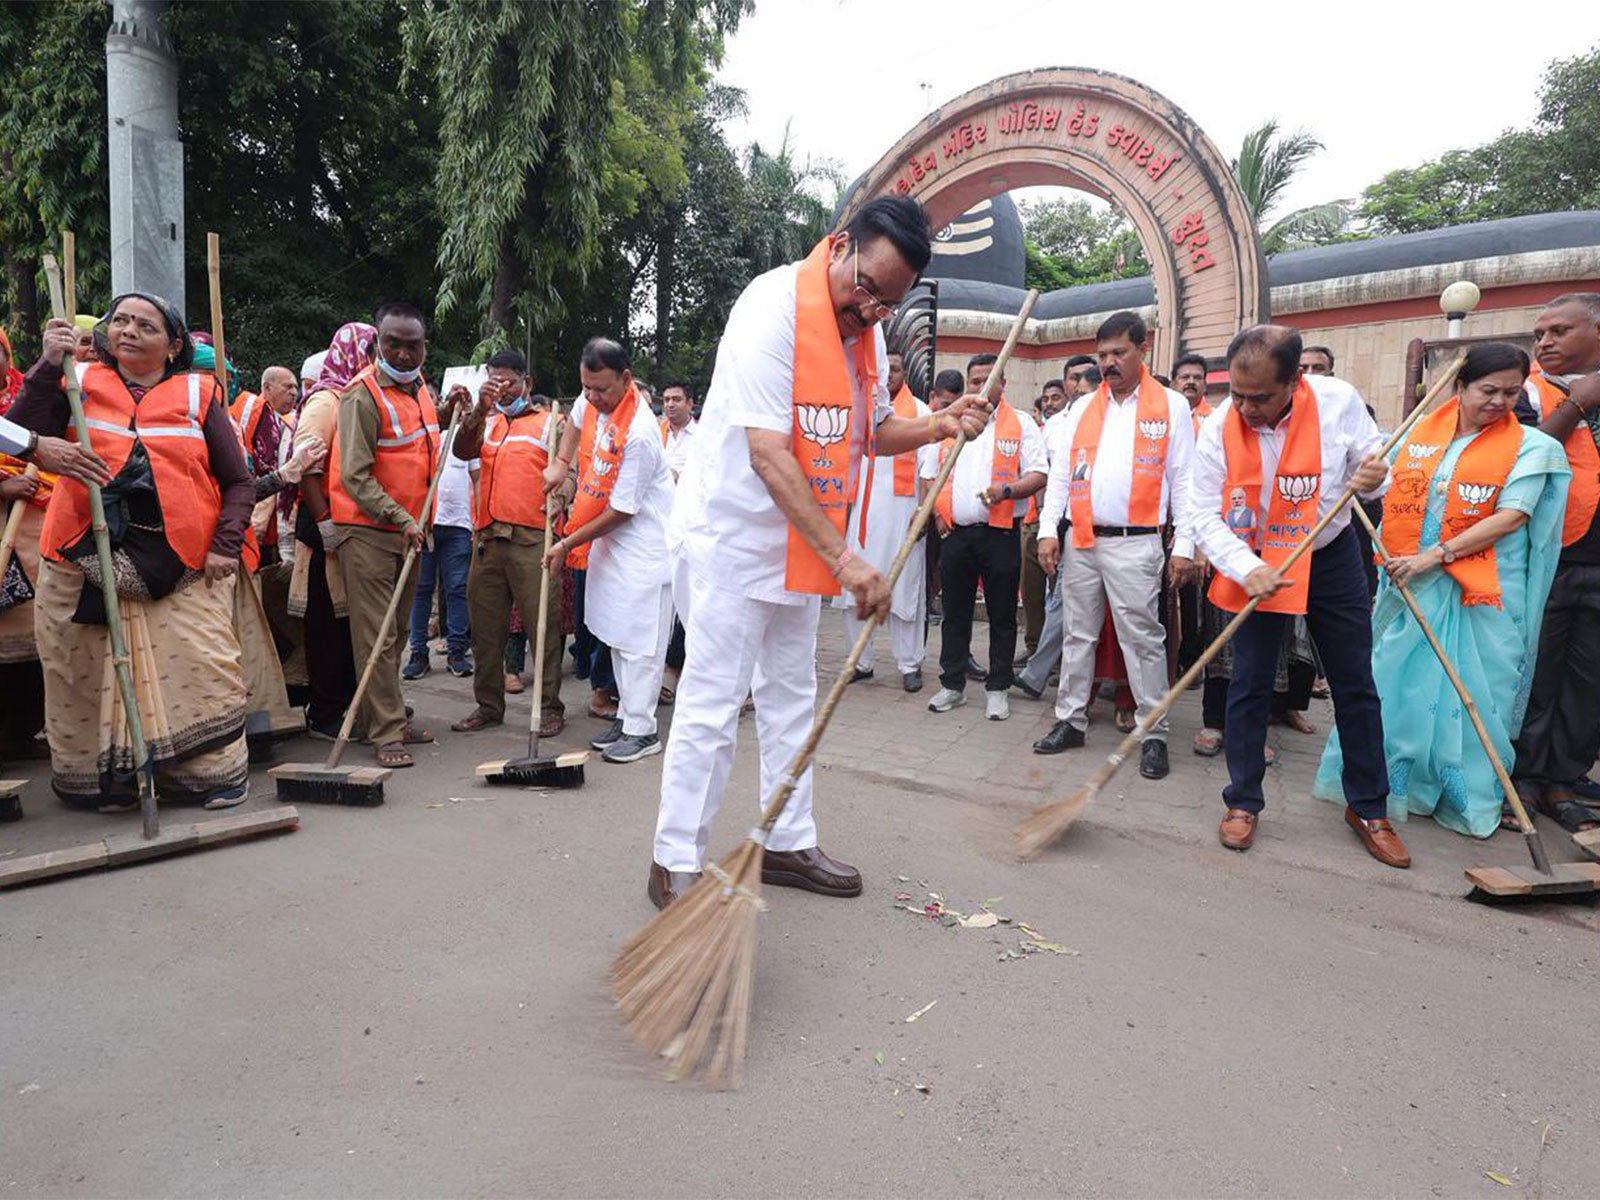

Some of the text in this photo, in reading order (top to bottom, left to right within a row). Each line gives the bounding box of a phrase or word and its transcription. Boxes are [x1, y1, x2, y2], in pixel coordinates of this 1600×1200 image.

[889, 156, 938, 197] હાદેવ
[1067, 100, 1099, 137] હેડ
[1172, 208, 1216, 273] સુરત
